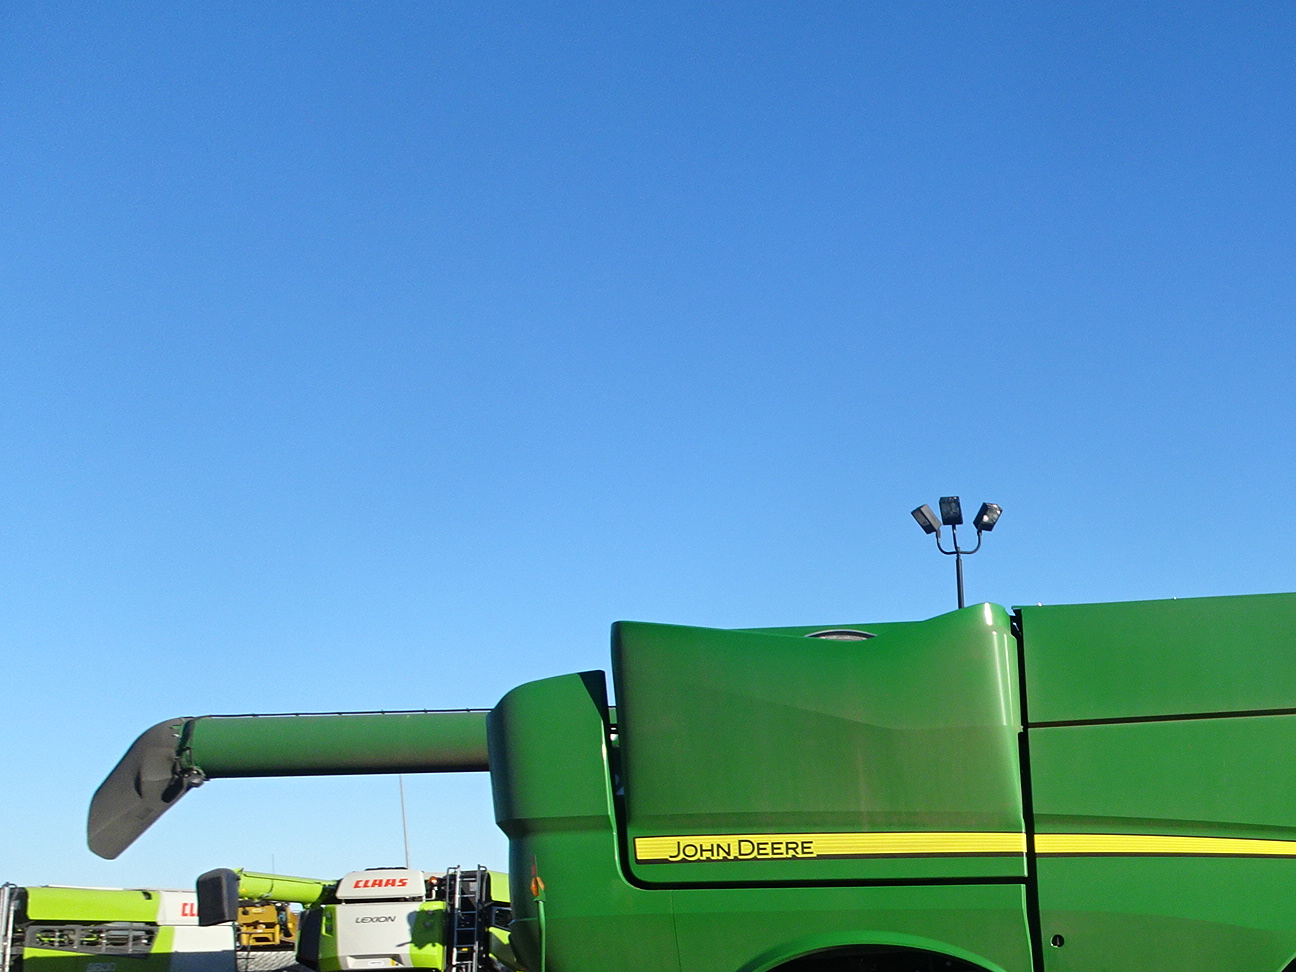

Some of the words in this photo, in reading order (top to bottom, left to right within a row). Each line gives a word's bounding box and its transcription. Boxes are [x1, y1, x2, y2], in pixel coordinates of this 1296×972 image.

[669, 841, 731, 859] JOHN
[738, 839, 814, 857] DEERE
[353, 878, 408, 889] CLAAS
[355, 916, 396, 924] LEXION
